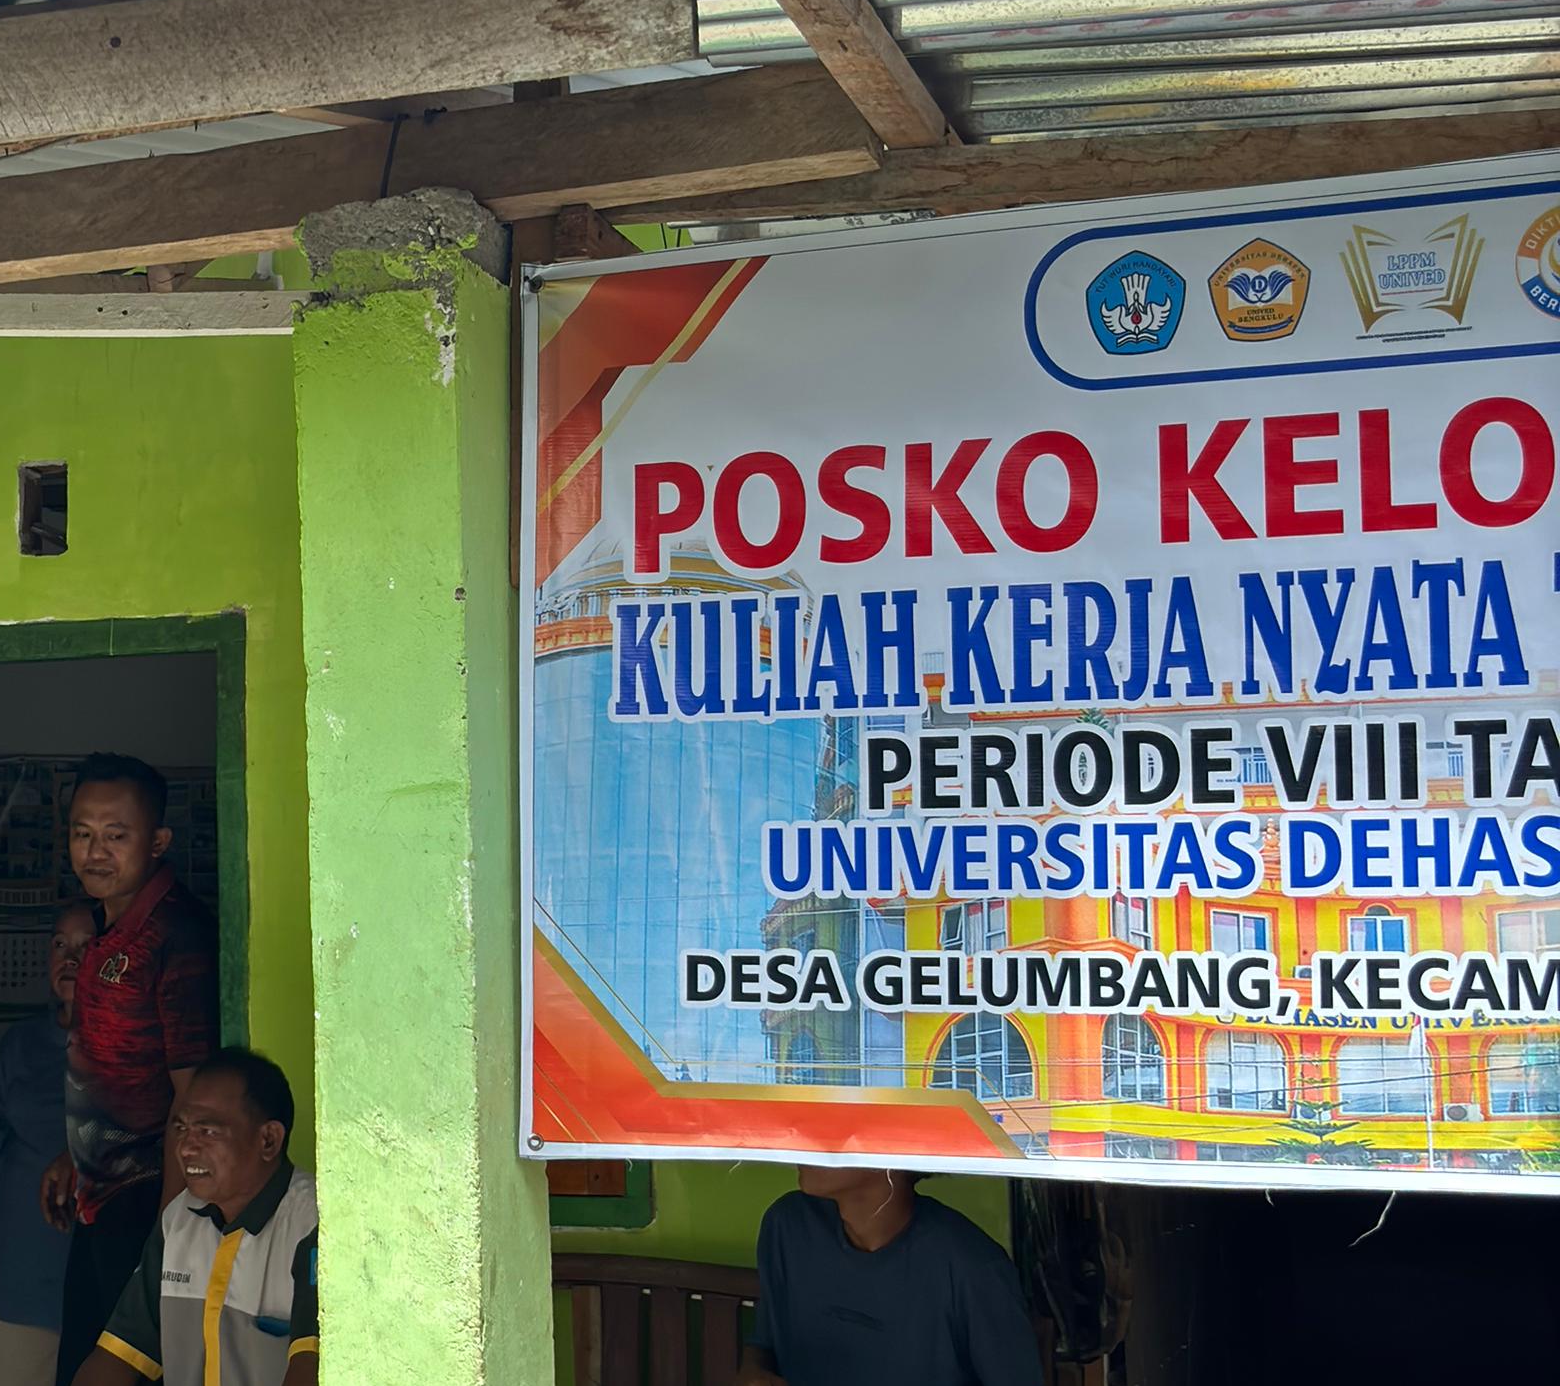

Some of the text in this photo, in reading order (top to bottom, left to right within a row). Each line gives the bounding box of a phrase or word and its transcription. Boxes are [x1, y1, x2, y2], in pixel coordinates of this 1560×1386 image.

[1378, 268, 1446, 289] UNIVED
[1386, 251, 1437, 271] LPPM
[1237, 312, 1284, 323] BENGKULU
[1529, 284, 1560, 311] BER
[634, 397, 1555, 574] POSKO KELO
[615, 557, 1530, 717] KULIAH KERJA NYATA
[866, 717, 1560, 810] PERIODE VIII TA
[768, 815, 1560, 893] UNIVERSITAS DEHAS
[685, 954, 1560, 1017] DESA GELUMBANG, KECAM
[1246, 1008, 1378, 1029] ASEN
